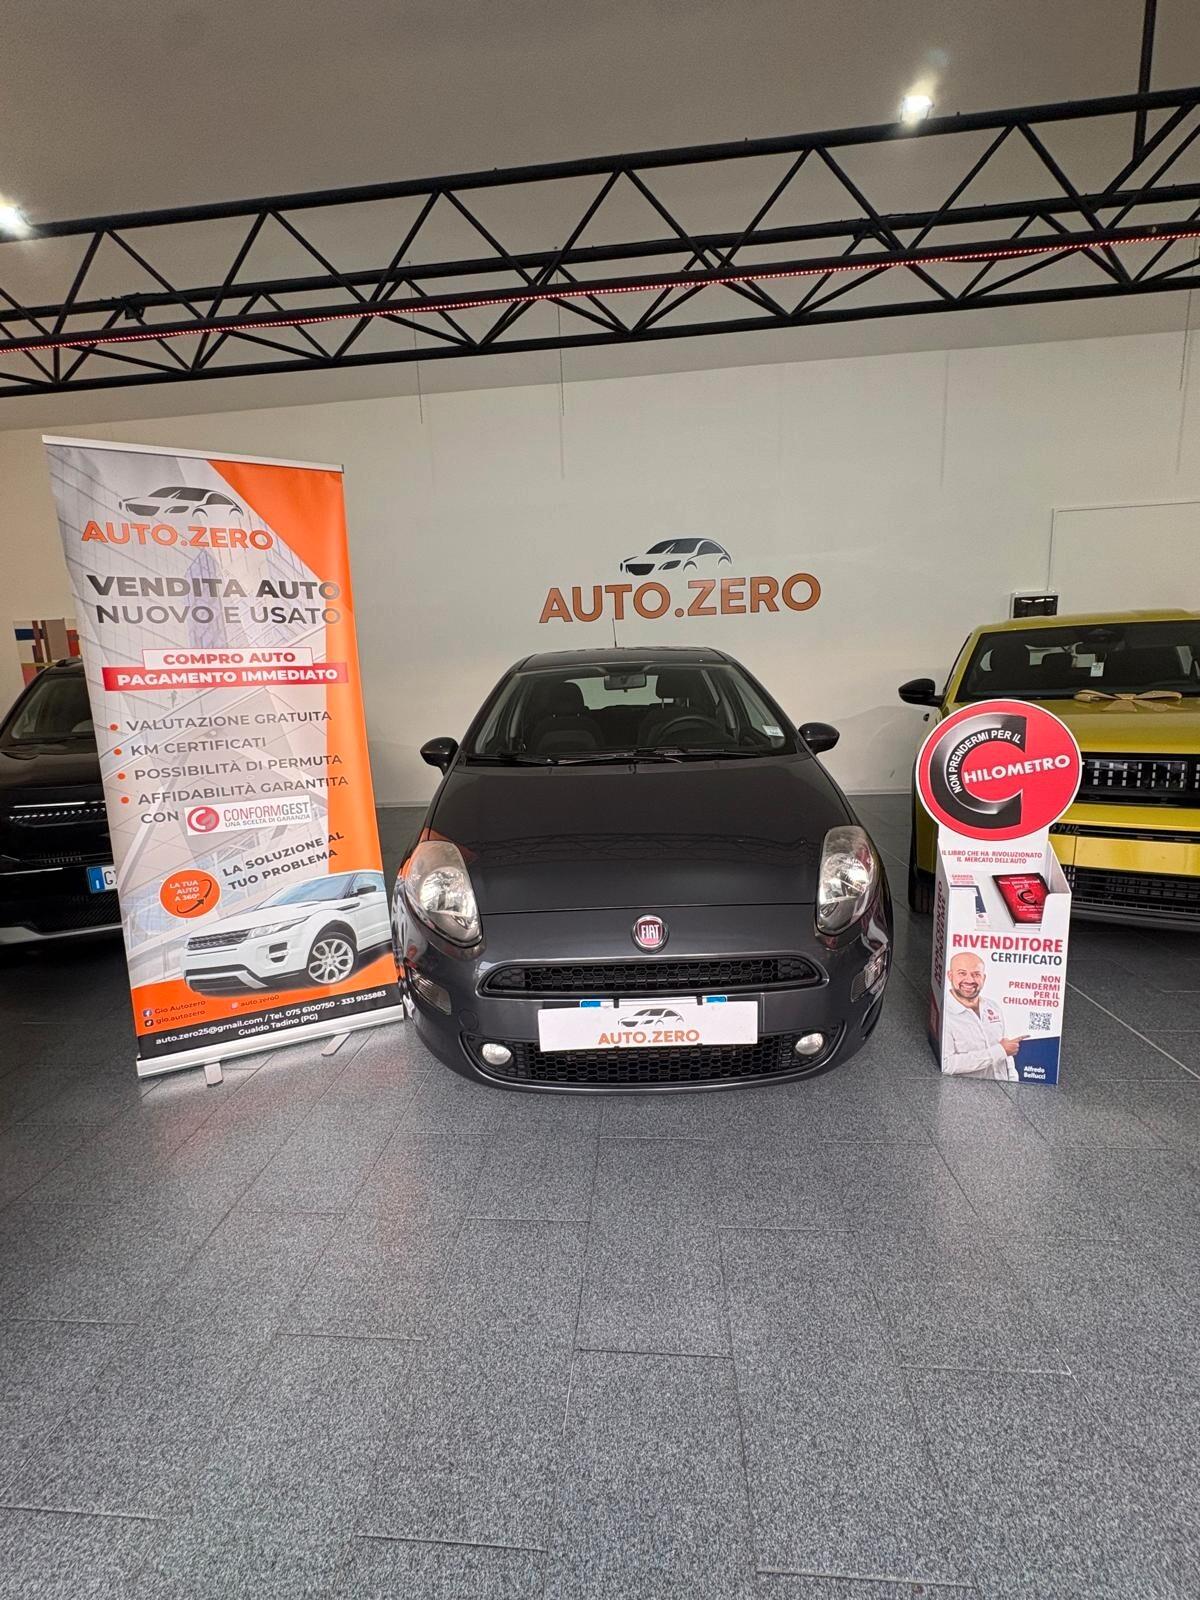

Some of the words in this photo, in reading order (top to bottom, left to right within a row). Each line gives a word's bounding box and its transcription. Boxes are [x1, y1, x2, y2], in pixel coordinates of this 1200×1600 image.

[81, 520, 274, 551] AUTO.ZERO
[86, 574, 247, 599] VENDITA
[256, 580, 341, 601] AUTO
[539, 572, 822, 624] AUTO.ZERO
[96, 604, 214, 625] NUOVO
[225, 606, 240, 624] E
[251, 606, 341, 625] USATO
[163, 653, 244, 666] COMPRO
[248, 652, 296, 664] AUTO
[116, 671, 237, 687] PAGAMENTO
[241, 668, 338, 683] IMMEDIATO
[126, 715, 250, 732] VALUTAZIONE
[255, 711, 332, 725] GRATUITA
[991, 730, 1011, 739] PER
[1013, 733, 1022, 744] IL
[130, 744, 159, 757] KM
[164, 737, 266, 754] CERTIFICATI
[949, 732, 989, 773] PRENDERMI
[135, 760, 242, 781] POSSIBILITÀ
[247, 760, 263, 772] DI
[268, 754, 343, 770] PERMUTA
[963, 755, 1071, 784] HILOMETRO
[138, 782, 257, 806] AFFIDABILITÀ
[261, 776, 349, 794] GARANTITA
[949, 774, 963, 794] NON
[141, 811, 179, 824] CON
[223, 802, 309, 822] CONFORMGEST
[242, 819, 267, 827] SCELTA
[277, 814, 311, 823] GARANZIA
[222, 864, 243, 877] LA
[245, 838, 325, 870] SOLUZIONE
[327, 831, 344, 844] AL
[228, 875, 259, 891] TUO
[262, 848, 338, 881] PROBLEMA
[176, 886, 200, 895] AUTO
[640, 924, 660, 939] FIAT
[952, 934, 1063, 953] RIVENDITORE
[991, 952, 1062, 966] CERTIFICATO
[1008, 981, 1061, 992] PRENDERMI
[1041, 975, 1061, 984] NON
[1002, 996, 1059, 1008] CHILOMETRO
[1033, 990, 1051, 999] PER
[1052, 991, 1060, 1000] IL
[170, 1000, 206, 1013] Autozero
[155, 1015, 263, 1045] auto.zero25@gmail.com
[269, 1011, 285, 1021] Tel.
[285, 1008, 301, 1017] 075
[341, 996, 356, 1006] 333
[238, 1024, 269, 1036] Gualdo
[270, 1017, 300, 1030] Tadino
[300, 1013, 319, 1025] (PG)
[598, 1029, 700, 1046] AUTO.ZERO
[1023, 1065, 1045, 1073] Alfredo
[1023, 1072, 1046, 1080] Bellucci
